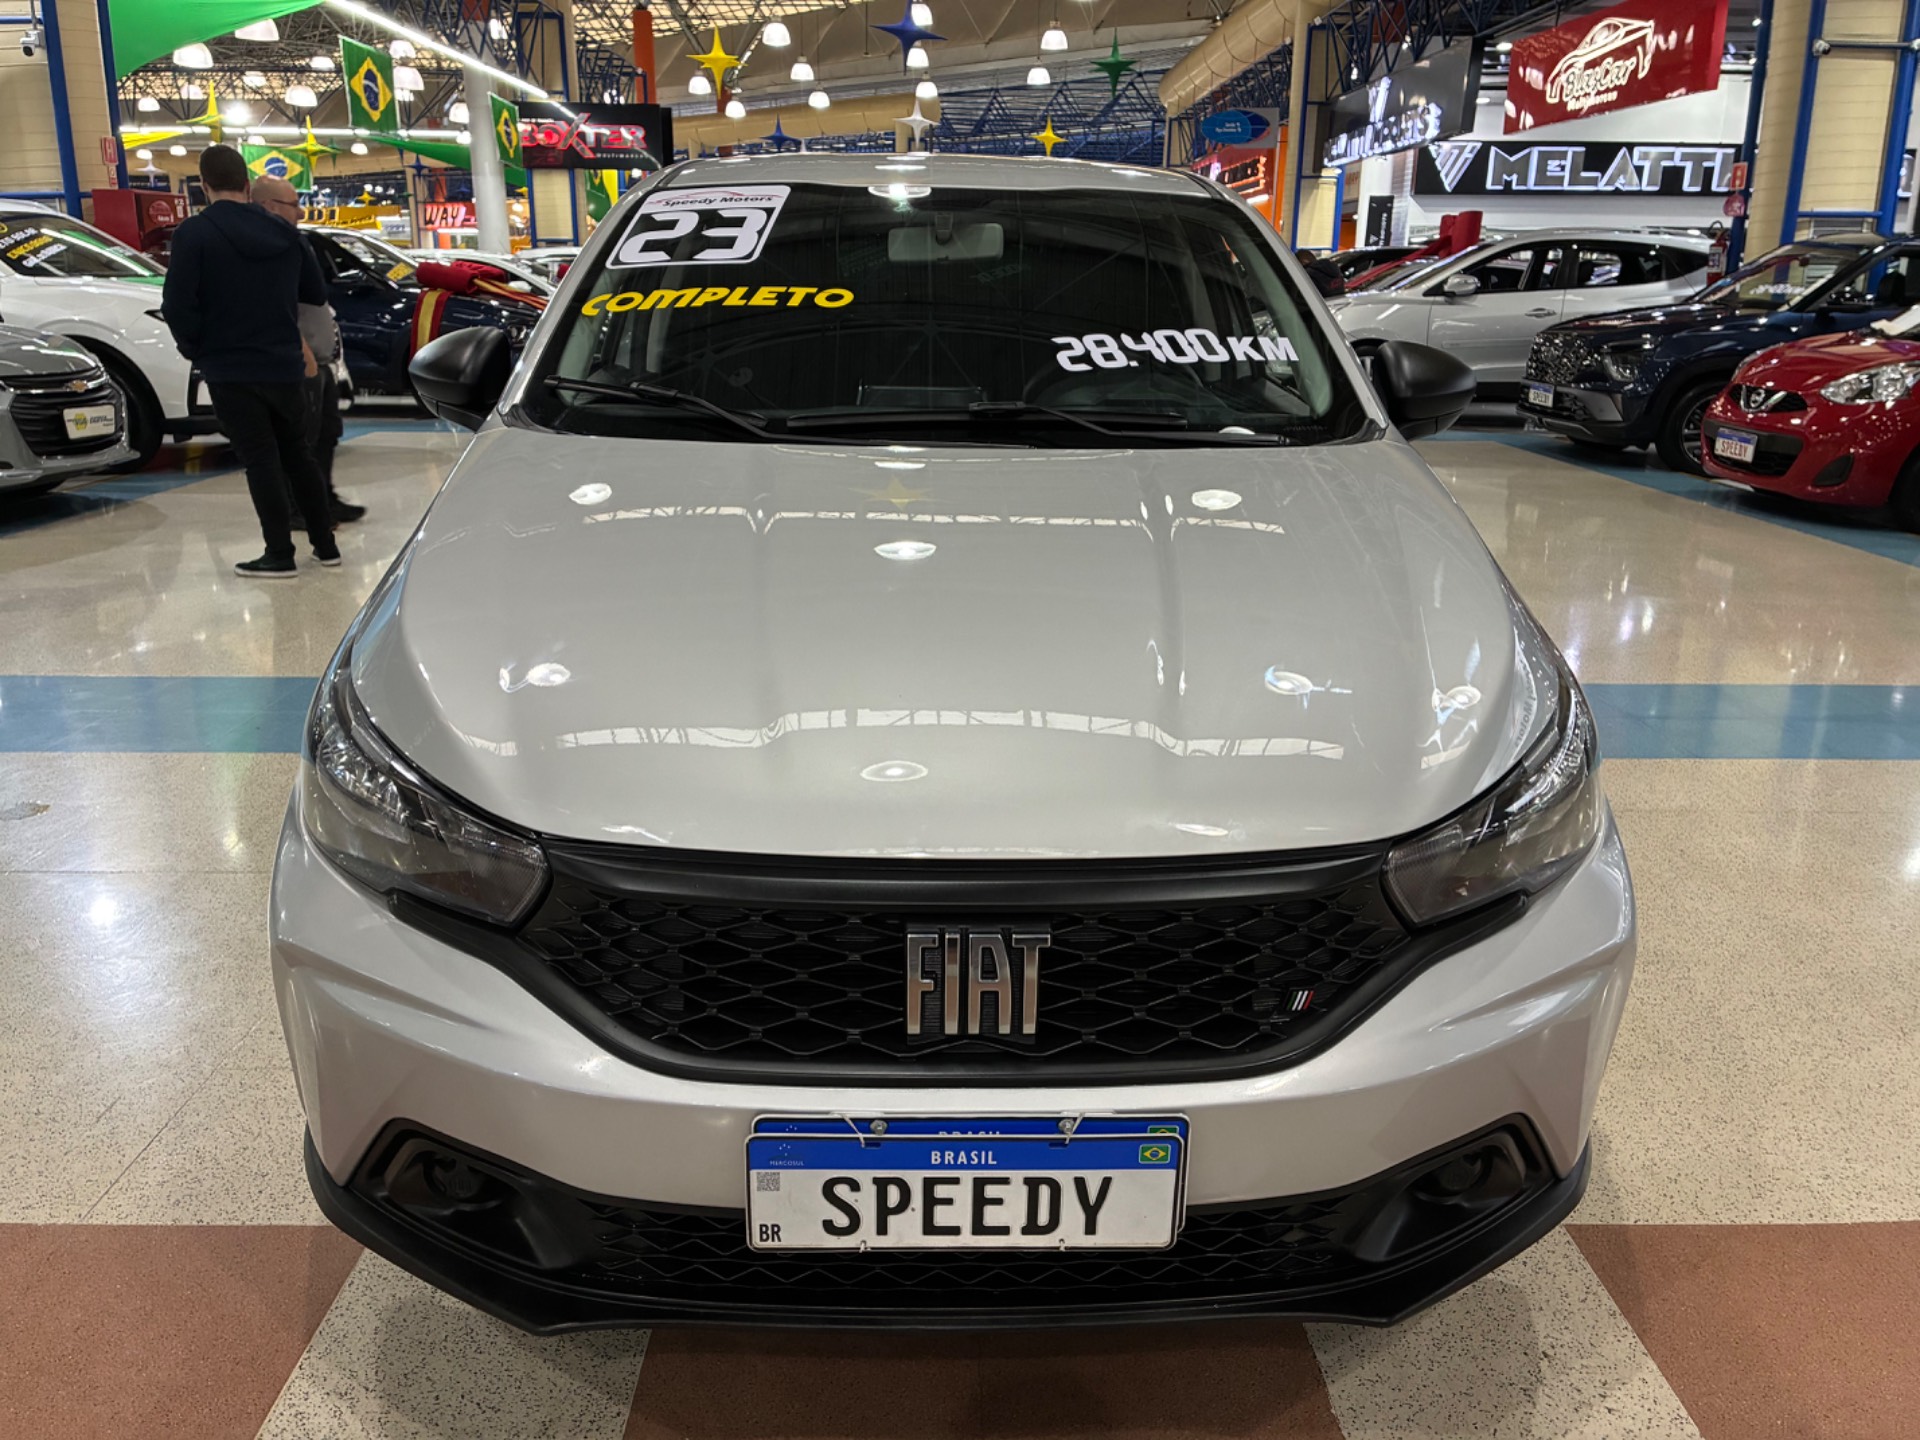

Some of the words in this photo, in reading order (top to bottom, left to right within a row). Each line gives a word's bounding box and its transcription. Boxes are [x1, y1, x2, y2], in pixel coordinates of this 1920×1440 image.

[662, 197, 717, 208] Speedy
[719, 196, 773, 204] Motors
[619, 207, 768, 263] 23
[581, 286, 854, 316] COMPLETO
[907, 934, 1050, 1034] FIAT
[931, 1151, 997, 1165] BRASIL
[822, 1176, 1112, 1236] SPEEDY
[759, 1224, 782, 1242] BR
